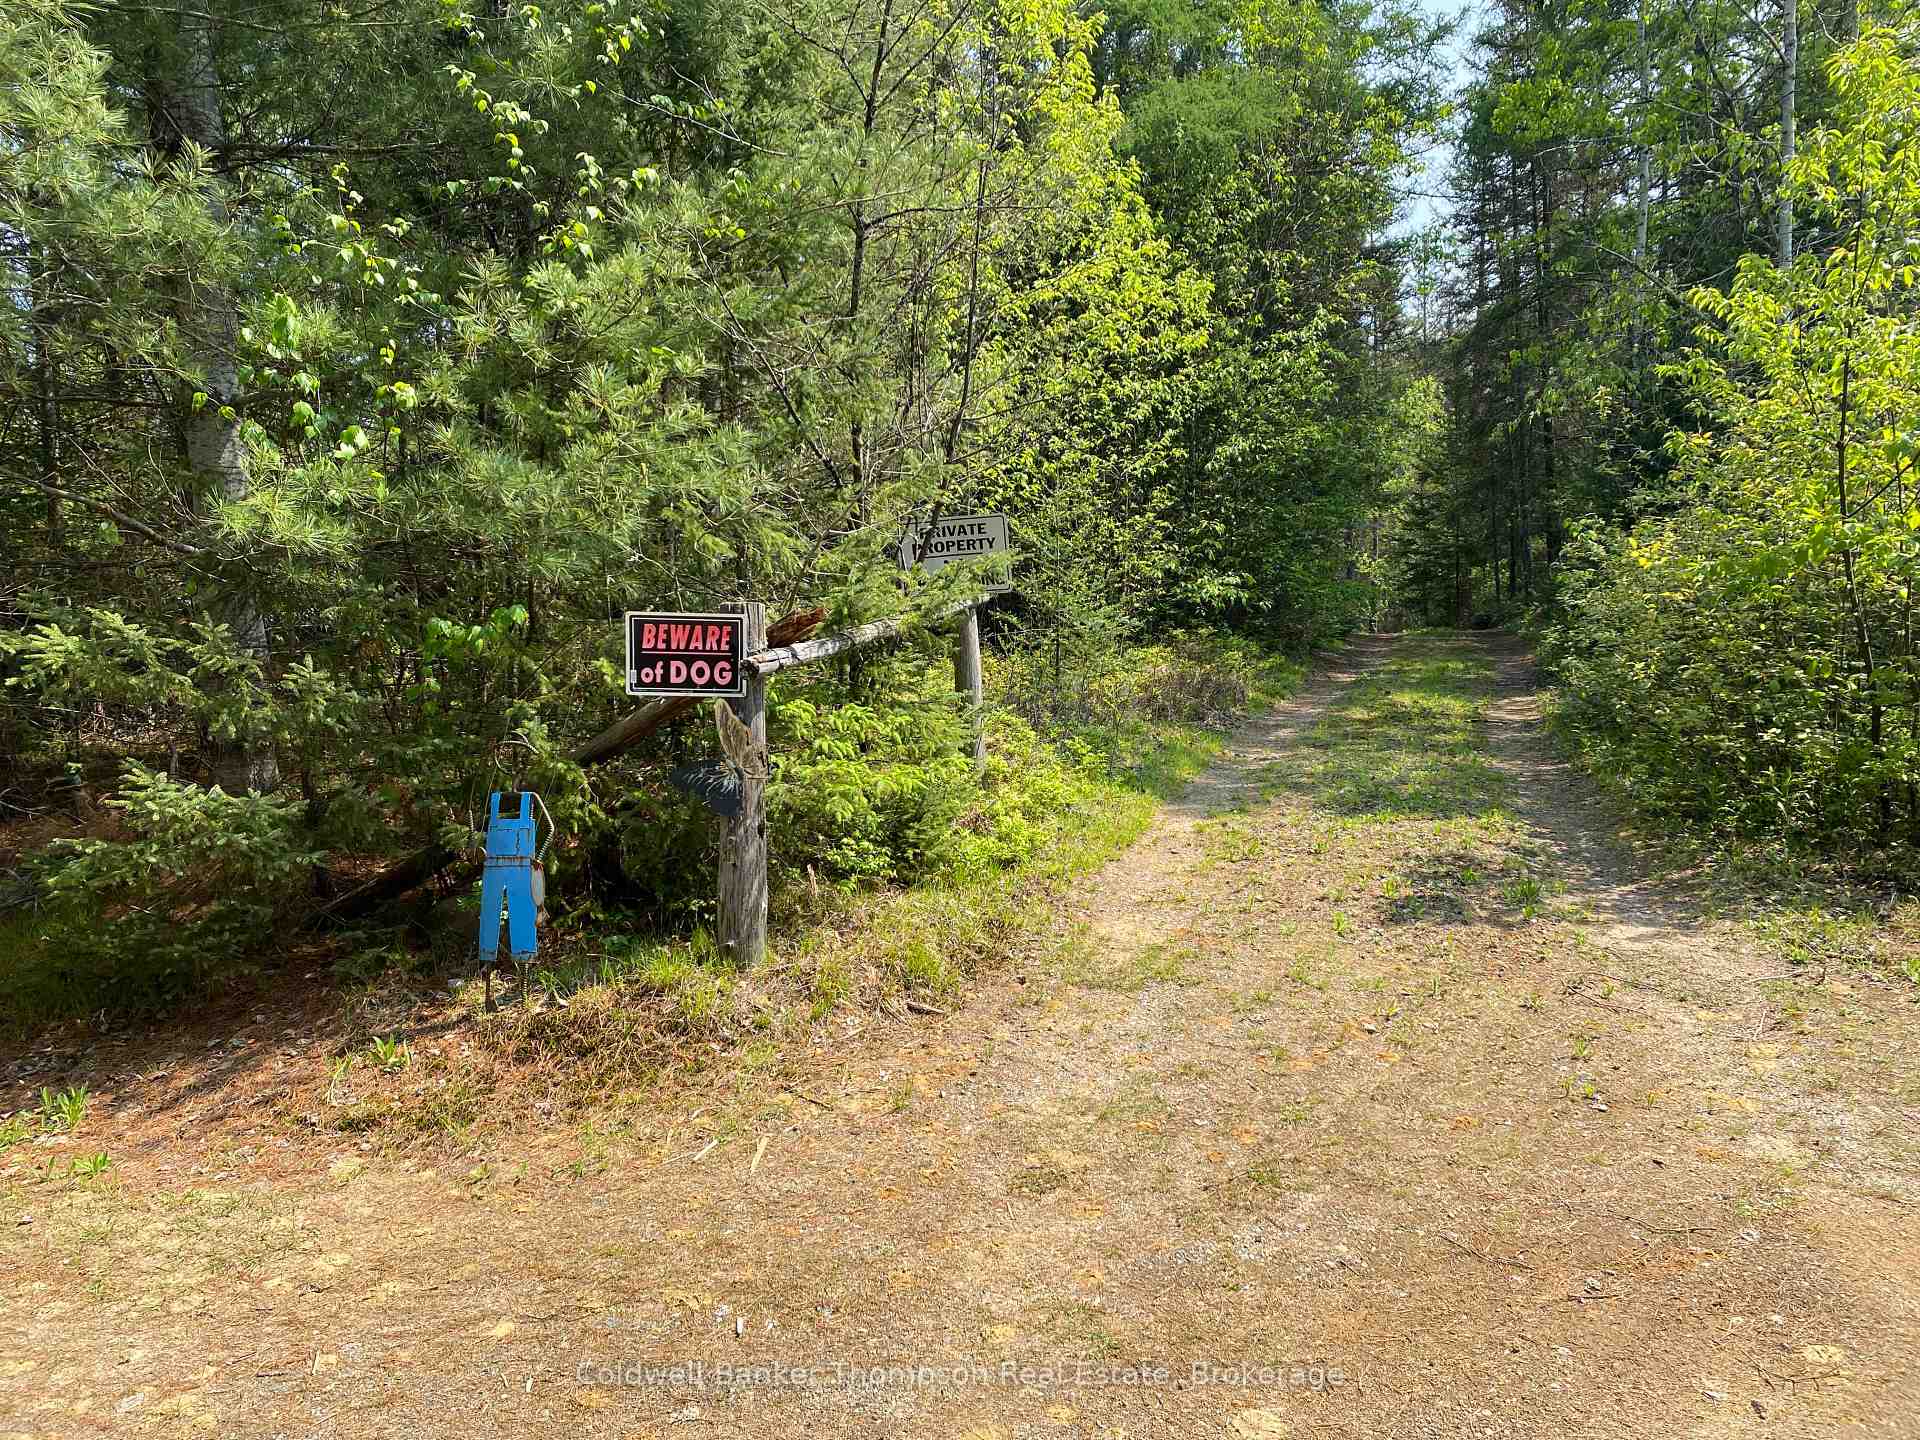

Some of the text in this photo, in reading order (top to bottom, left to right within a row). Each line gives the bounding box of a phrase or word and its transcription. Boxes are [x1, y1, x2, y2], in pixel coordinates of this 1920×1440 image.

[641, 623, 732, 651] BEWARE
[640, 660, 732, 685] of DOG
